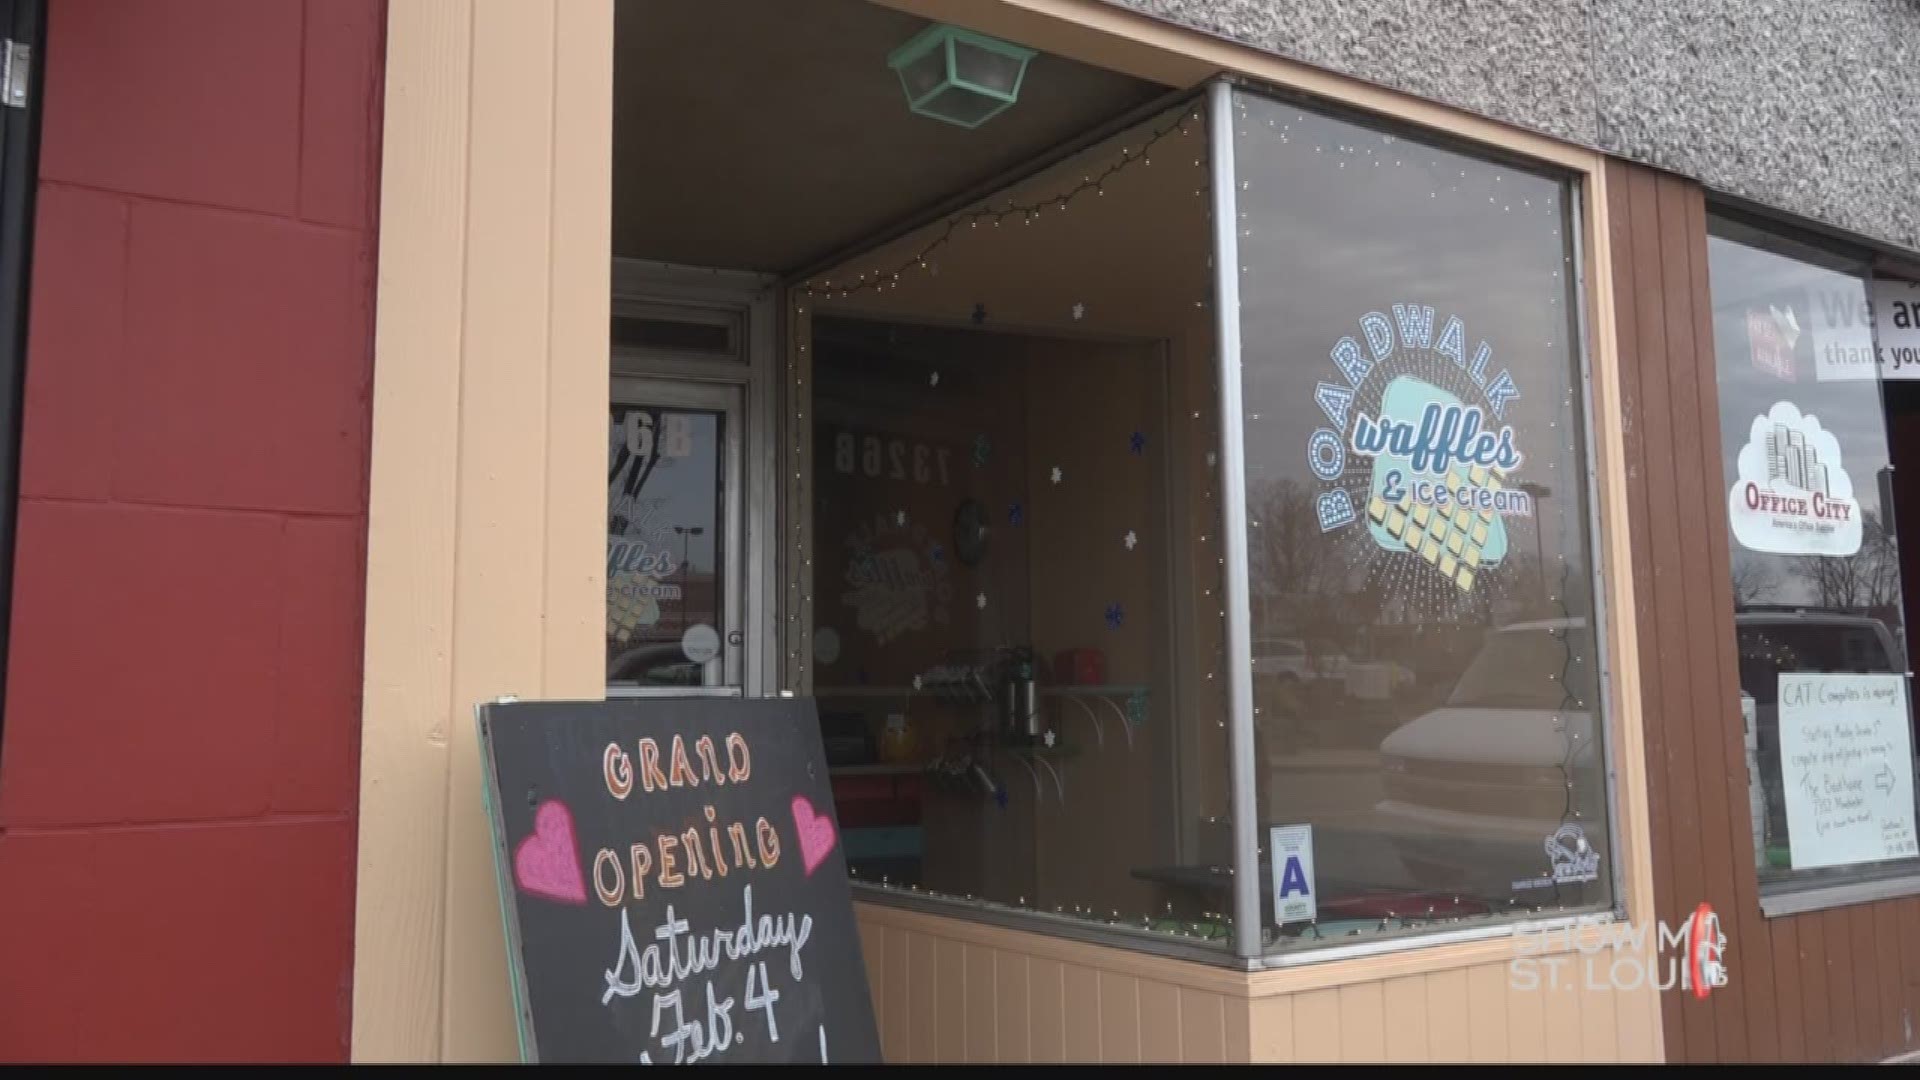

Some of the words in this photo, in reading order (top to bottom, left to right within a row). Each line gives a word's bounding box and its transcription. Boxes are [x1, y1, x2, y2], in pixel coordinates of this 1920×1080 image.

[1824, 341, 1885, 365] thank
[1308, 303, 1520, 533] BOARDWALK
[1352, 402, 1523, 474] waffles
[1382, 468, 1407, 502] &
[1455, 485, 1531, 516] cream
[1745, 481, 1808, 517] OFFICE
[1813, 491, 1852, 522] CITY
[621, 585, 681, 600] cream
[1784, 682, 1812, 707] CAT
[603, 732, 750, 799] GRAND
[593, 806, 781, 906] OPENING
[1280, 856, 1310, 898] A
[602, 884, 812, 1005] Saturday
[651, 981, 744, 1065] Feb.
[744, 961, 779, 1042] 4
